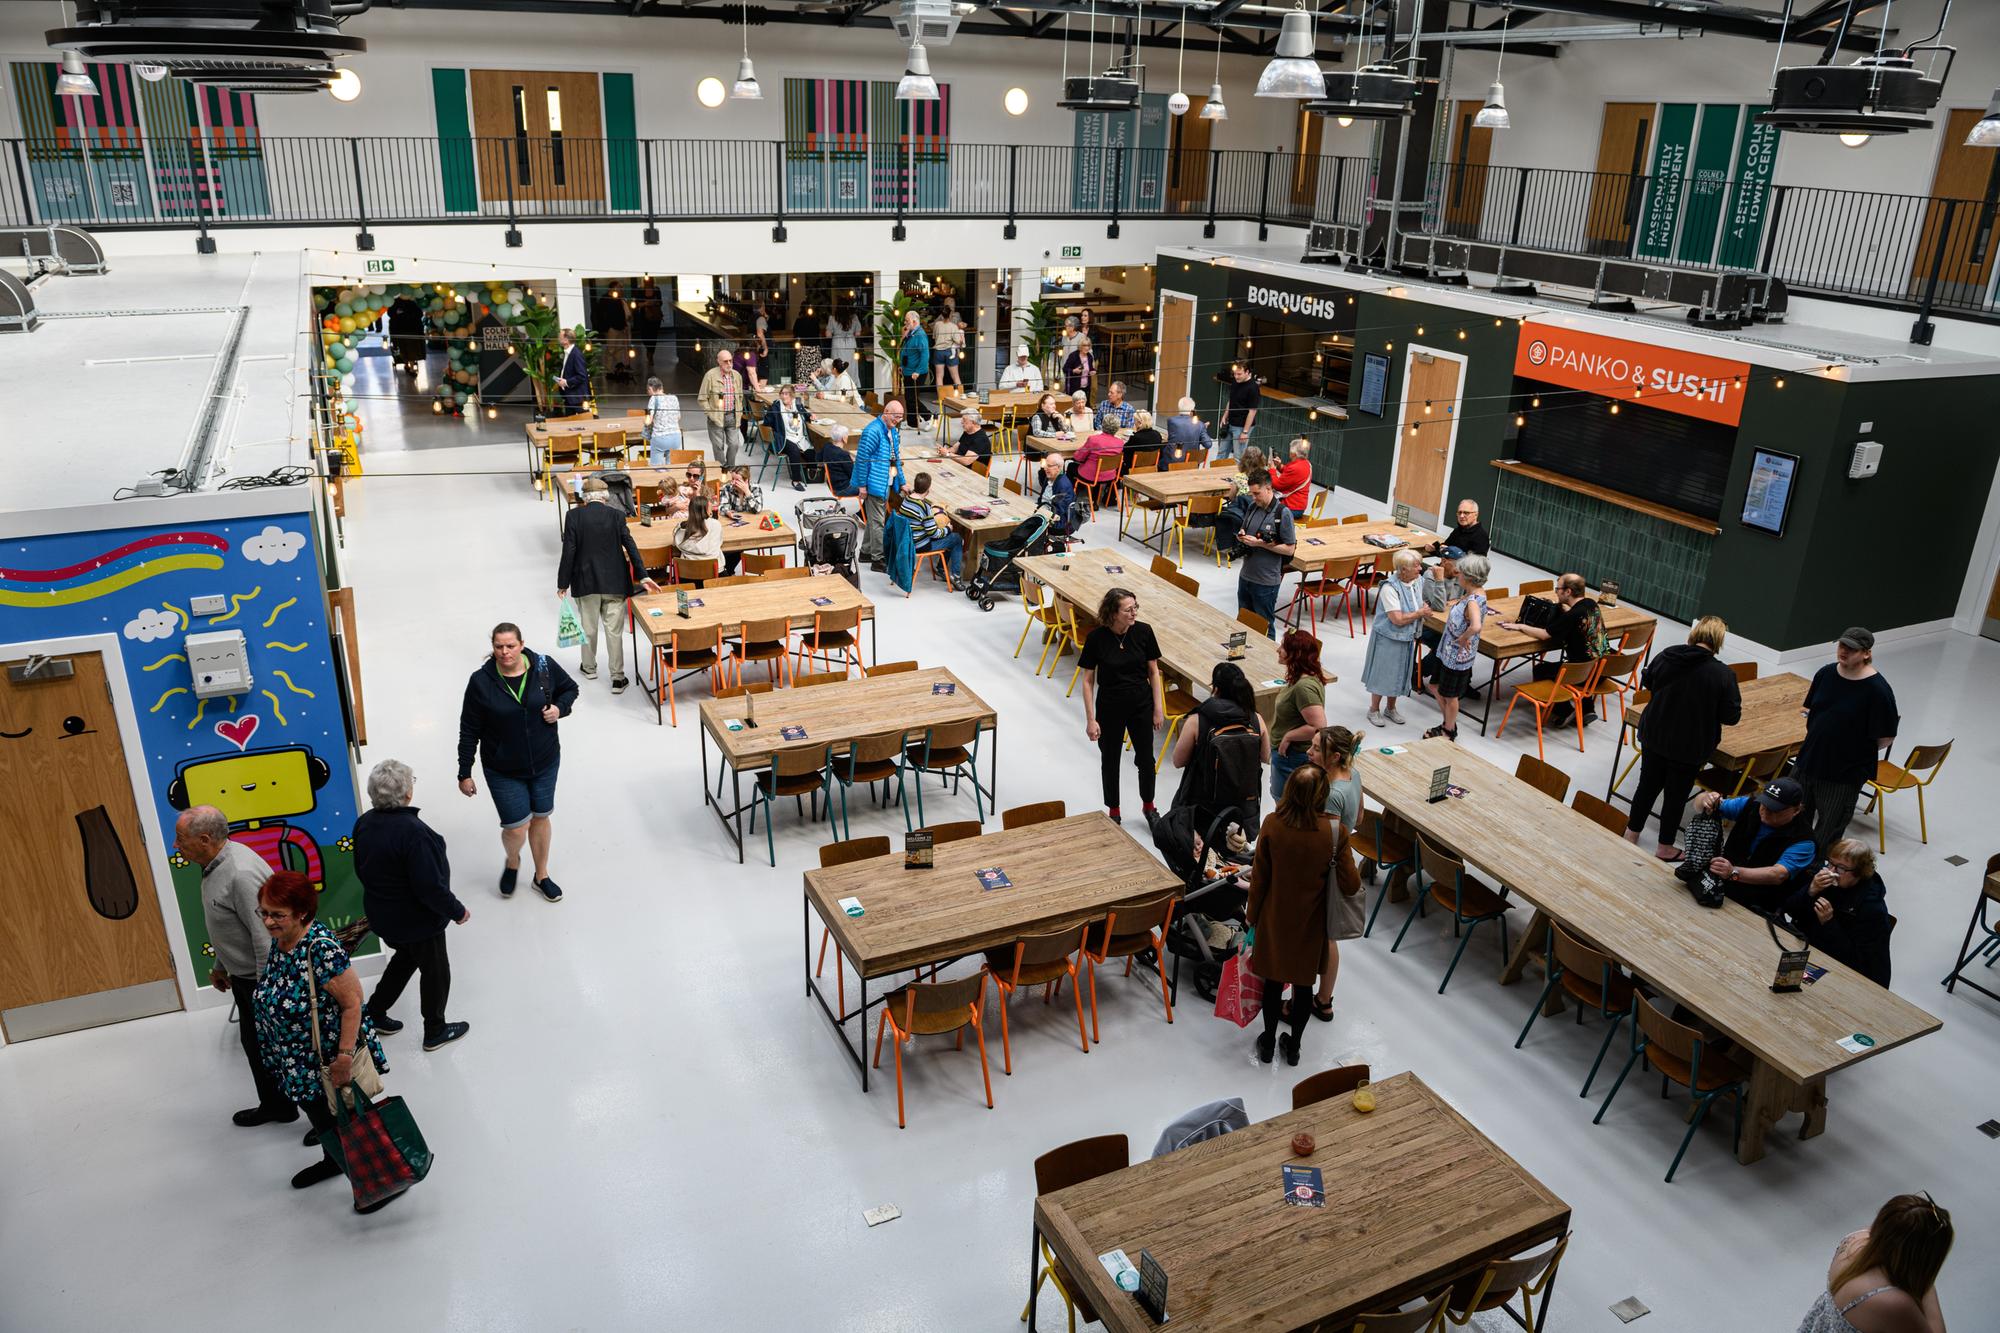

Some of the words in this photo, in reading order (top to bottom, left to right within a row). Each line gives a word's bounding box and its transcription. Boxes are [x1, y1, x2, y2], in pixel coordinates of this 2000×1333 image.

[1089, 113, 1100, 202] STRENGTHENIN
[1747, 124, 1764, 167] COLN
[1647, 143, 1673, 246] PASSIONATELY
[1658, 144, 1685, 247] INDEPENDENT
[1735, 174, 1755, 224] BETTER
[1749, 178, 1767, 223] TOWN
[1733, 228, 1744, 239] A
[1248, 285, 1335, 320] BOROUGHS
[1550, 346, 1629, 381] PANKO
[1632, 365, 1646, 385] &
[1650, 368, 1727, 404] SUSHI
